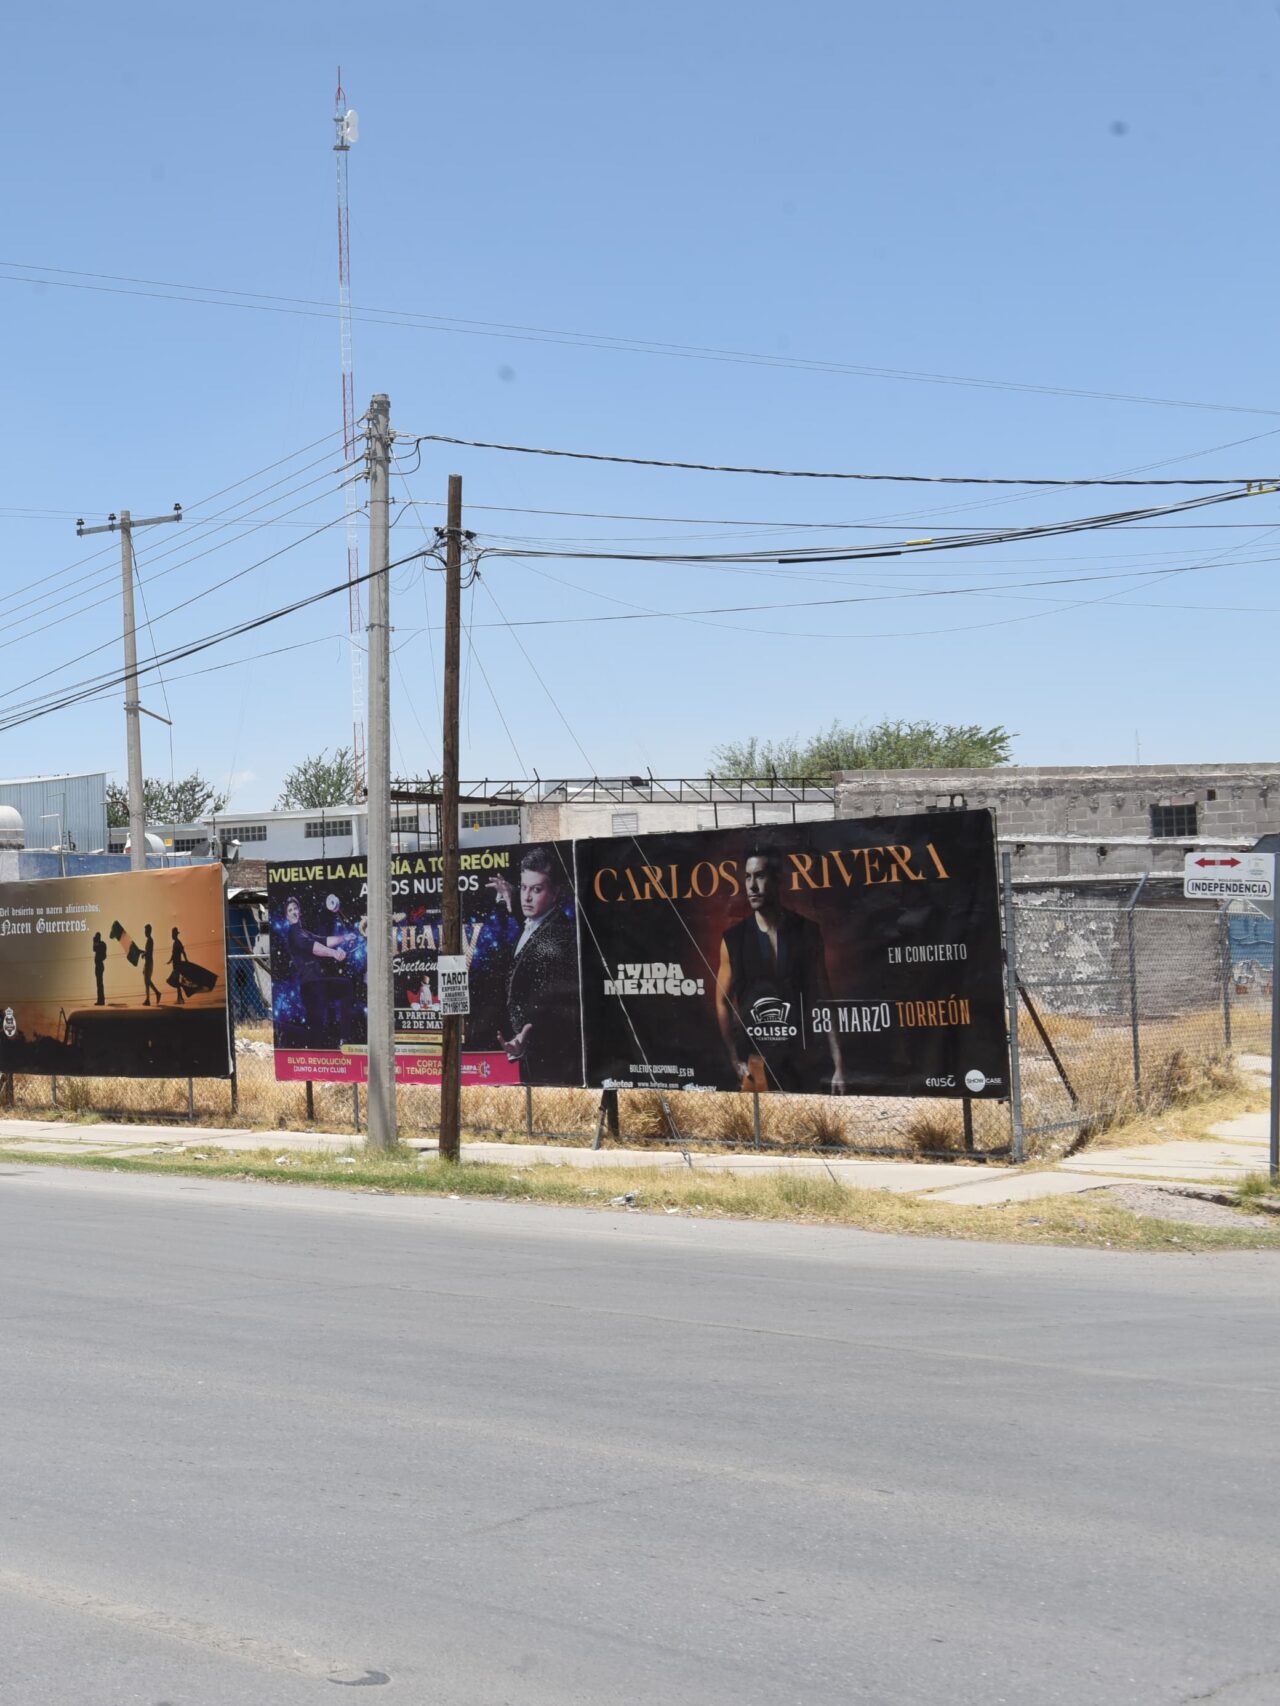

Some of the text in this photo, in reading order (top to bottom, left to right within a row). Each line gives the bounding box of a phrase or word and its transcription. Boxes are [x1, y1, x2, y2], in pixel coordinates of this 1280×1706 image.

[268, 865, 324, 884] ¡VUELVE
[326, 863, 345, 880] LA
[414, 857, 427, 874] A
[428, 849, 510, 873] TOREÓN!
[593, 842, 952, 903] CARLOS RIVERA
[413, 875, 479, 895] NUEOS
[1191, 881, 1268, 894] INDEPENDENCIA
[0, 907, 10, 917] Del
[0, 918, 90, 936] Nacen Guerreros.
[888, 943, 968, 964] EN CONCIERTO
[617, 962, 685, 980] ¡VIDA
[441, 972, 467, 986] TAROT
[398, 1011, 404, 1020] A
[405, 1011, 436, 1020] PARTIR
[811, 993, 971, 1033] 28 MARZO TORREÓN
[402, 1020, 413, 1029] 22
[413, 1020, 425, 1029] DE
[746, 1026, 798, 1037] COLISEO
[287, 1055, 352, 1066] BLVD. REVOLUCIÓN
[629, 1064, 653, 1073] BOLETOS
[687, 1067, 695, 1077] EN
